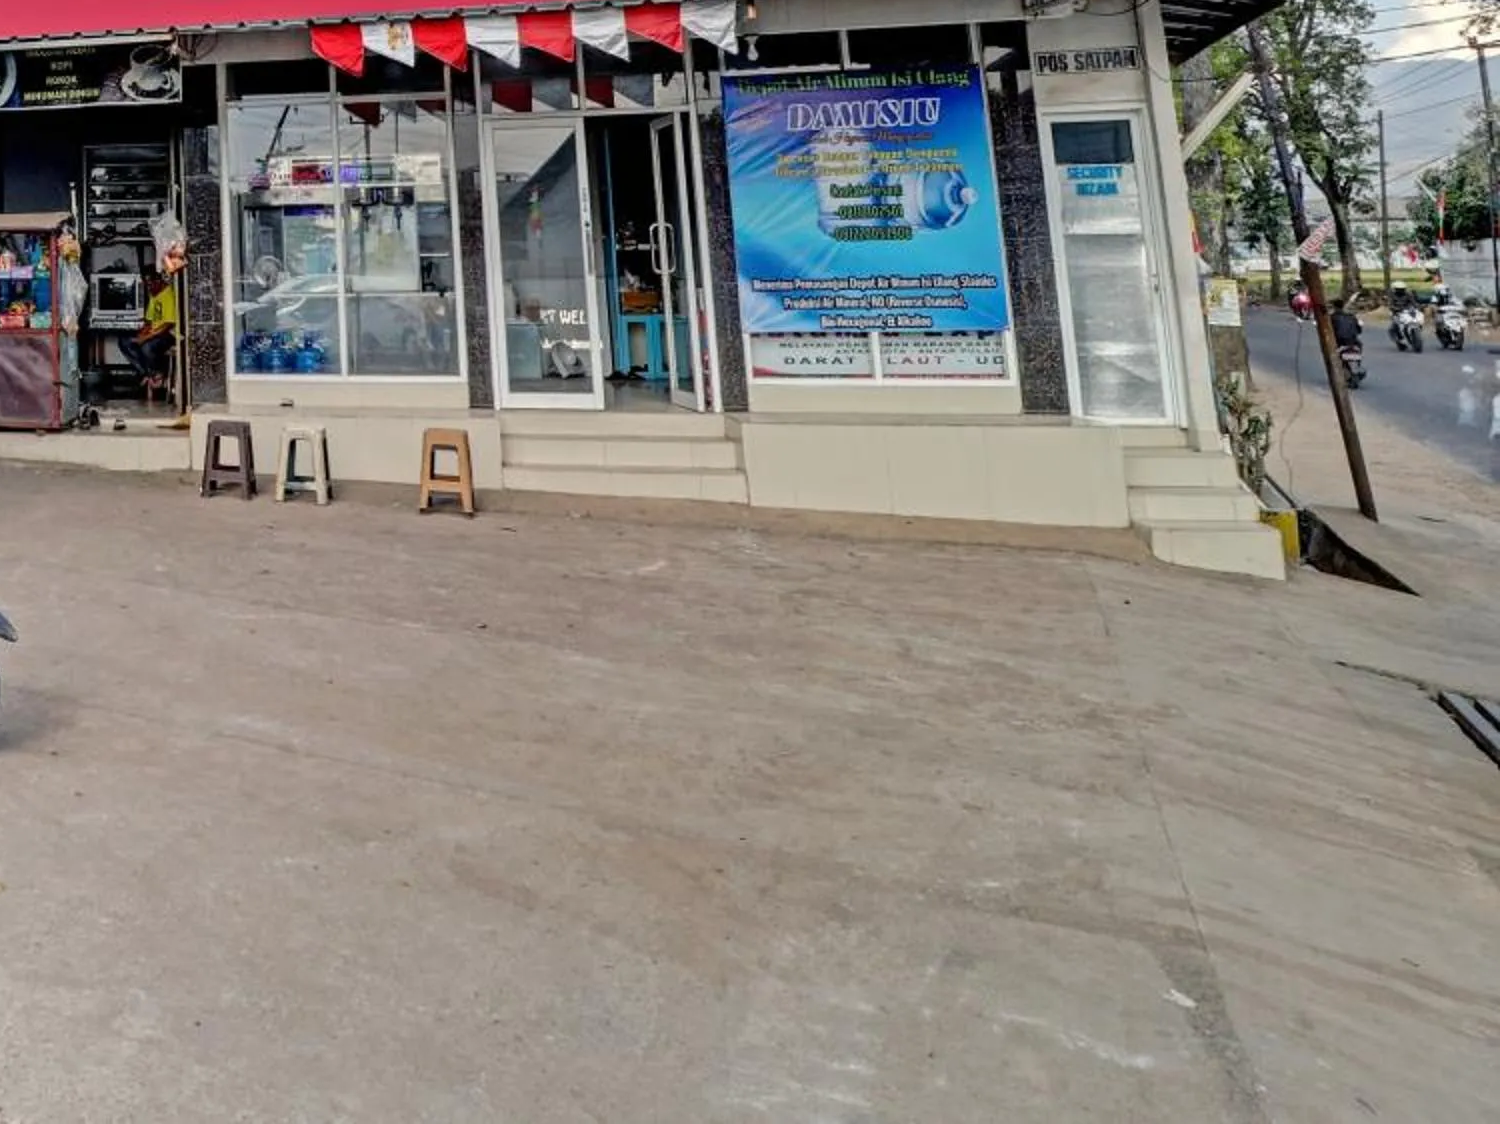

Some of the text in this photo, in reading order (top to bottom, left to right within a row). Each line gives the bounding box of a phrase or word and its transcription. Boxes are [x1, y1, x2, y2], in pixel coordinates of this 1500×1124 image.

[1037, 49, 1136, 73] POS SATPAM
[887, 356, 945, 365] LAUT
